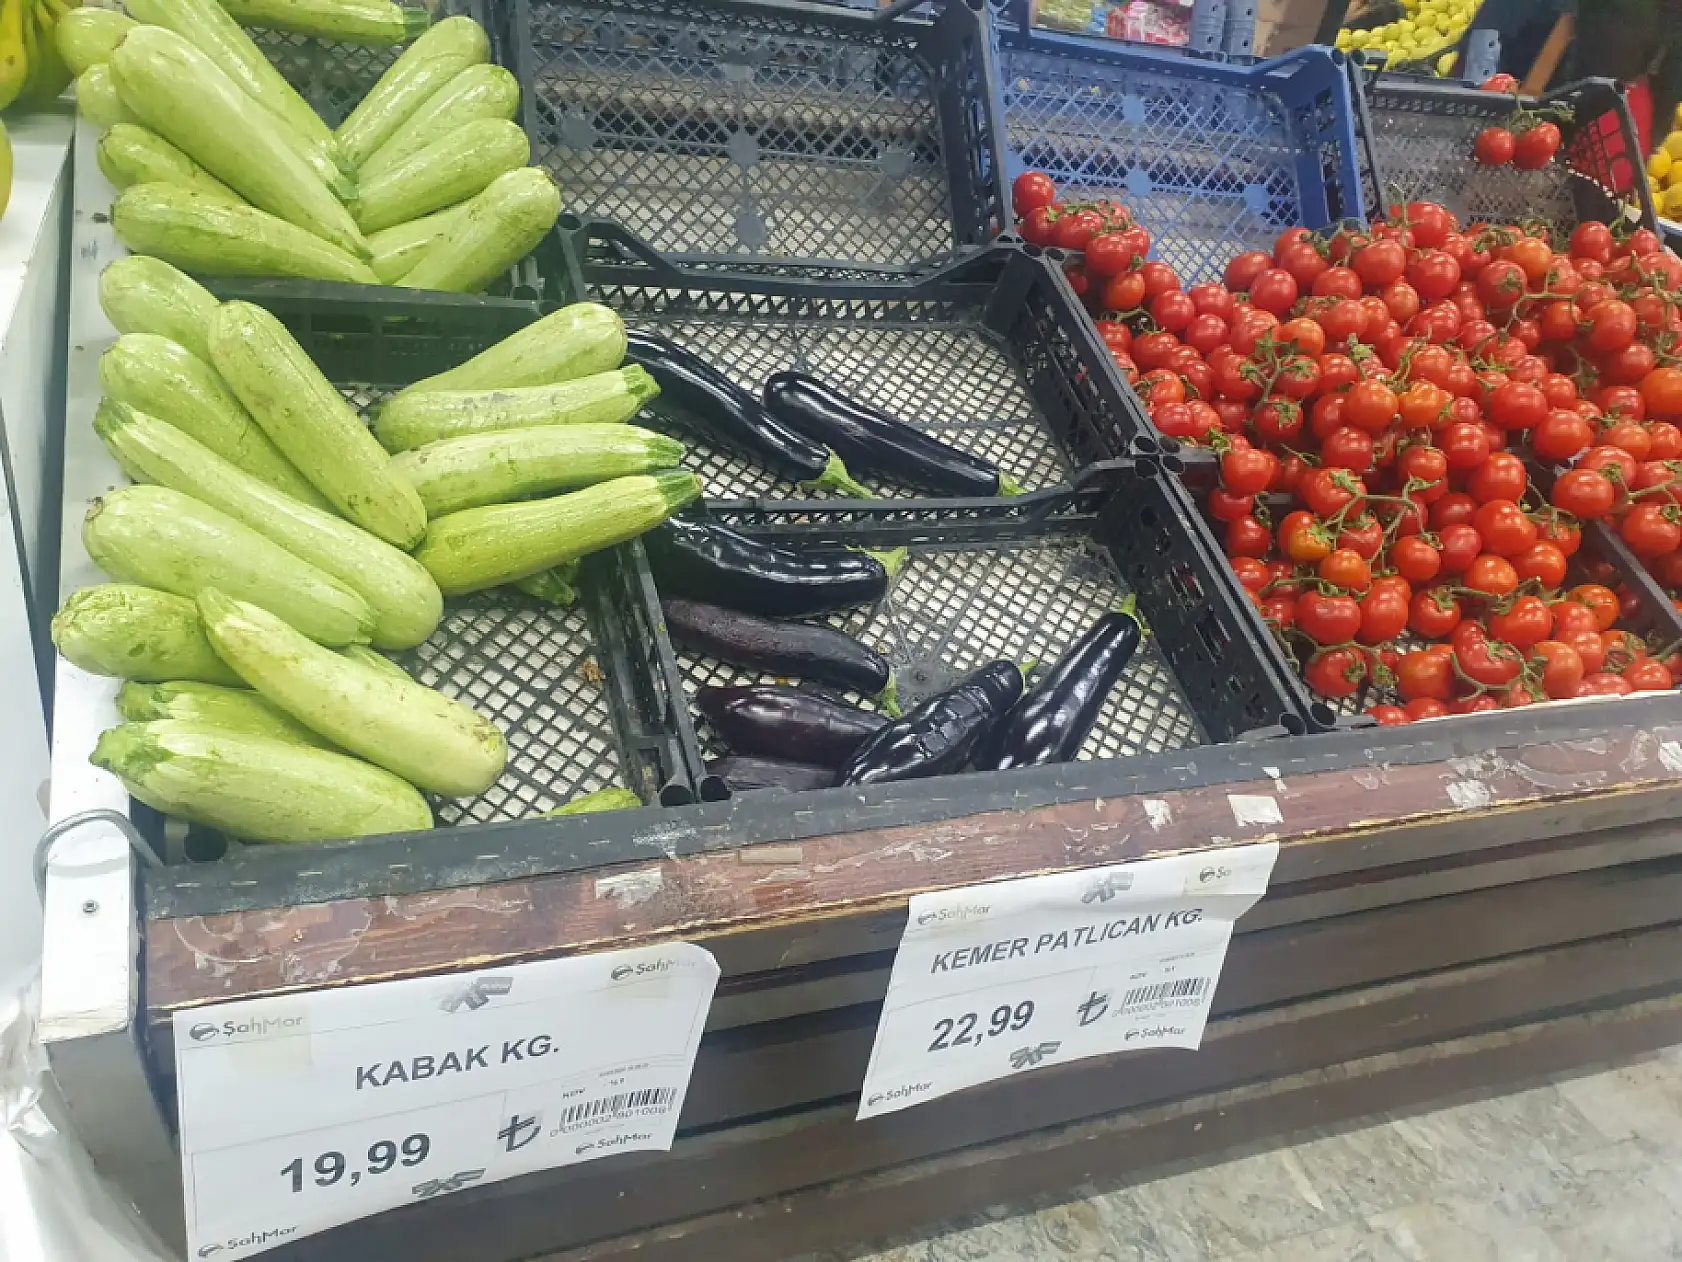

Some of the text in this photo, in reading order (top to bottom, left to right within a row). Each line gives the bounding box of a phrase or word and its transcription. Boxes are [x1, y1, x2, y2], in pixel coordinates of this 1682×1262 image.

[930, 908, 1204, 974] KEMER PATLICAN KG.
[927, 1000, 1036, 1053] 22,99
[355, 1034, 560, 1090] KABAK KG.
[280, 1132, 431, 1193] 19,99
